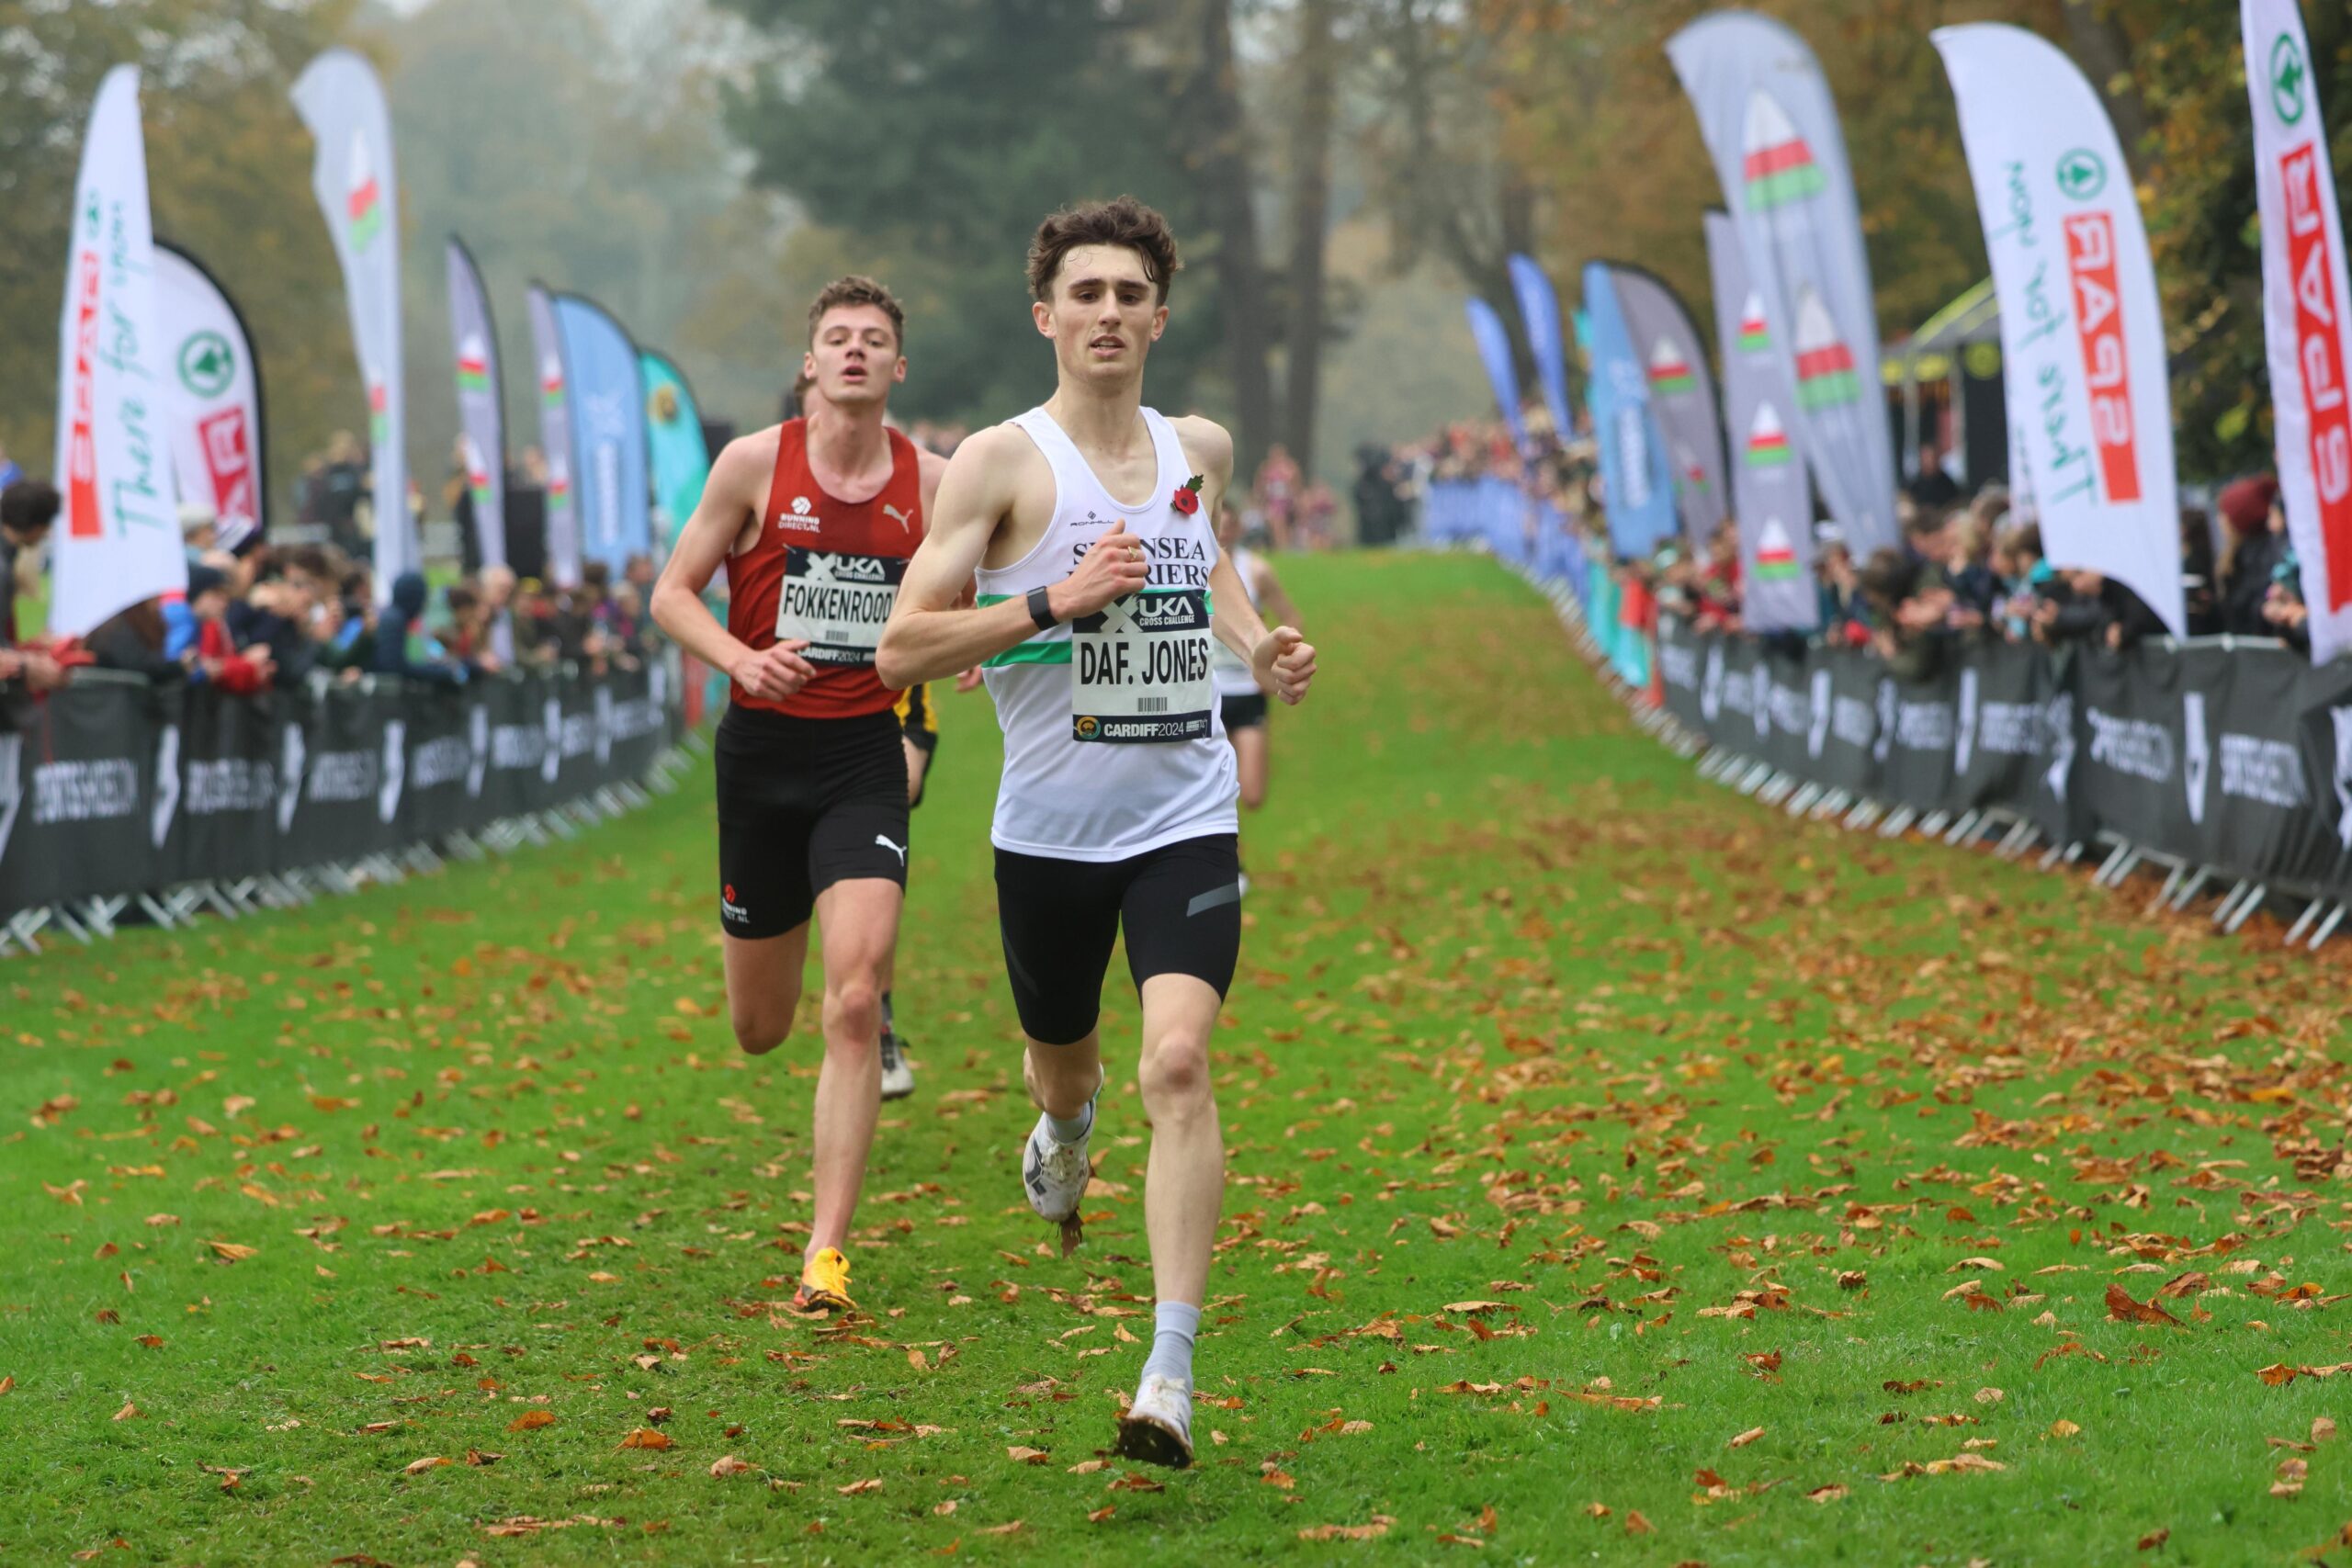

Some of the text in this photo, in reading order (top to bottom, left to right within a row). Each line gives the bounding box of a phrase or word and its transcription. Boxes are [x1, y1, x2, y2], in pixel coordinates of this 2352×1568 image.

[2285, 151, 2350, 505] SPAR
[1073, 537, 1206, 565] SNSEA
[784, 583, 892, 624] FOKKENROOD
[1139, 596, 1194, 617] UKA
[1139, 614, 1195, 626] CROSS CHALLENGE
[1080, 637, 1209, 685] DAF. JONES
